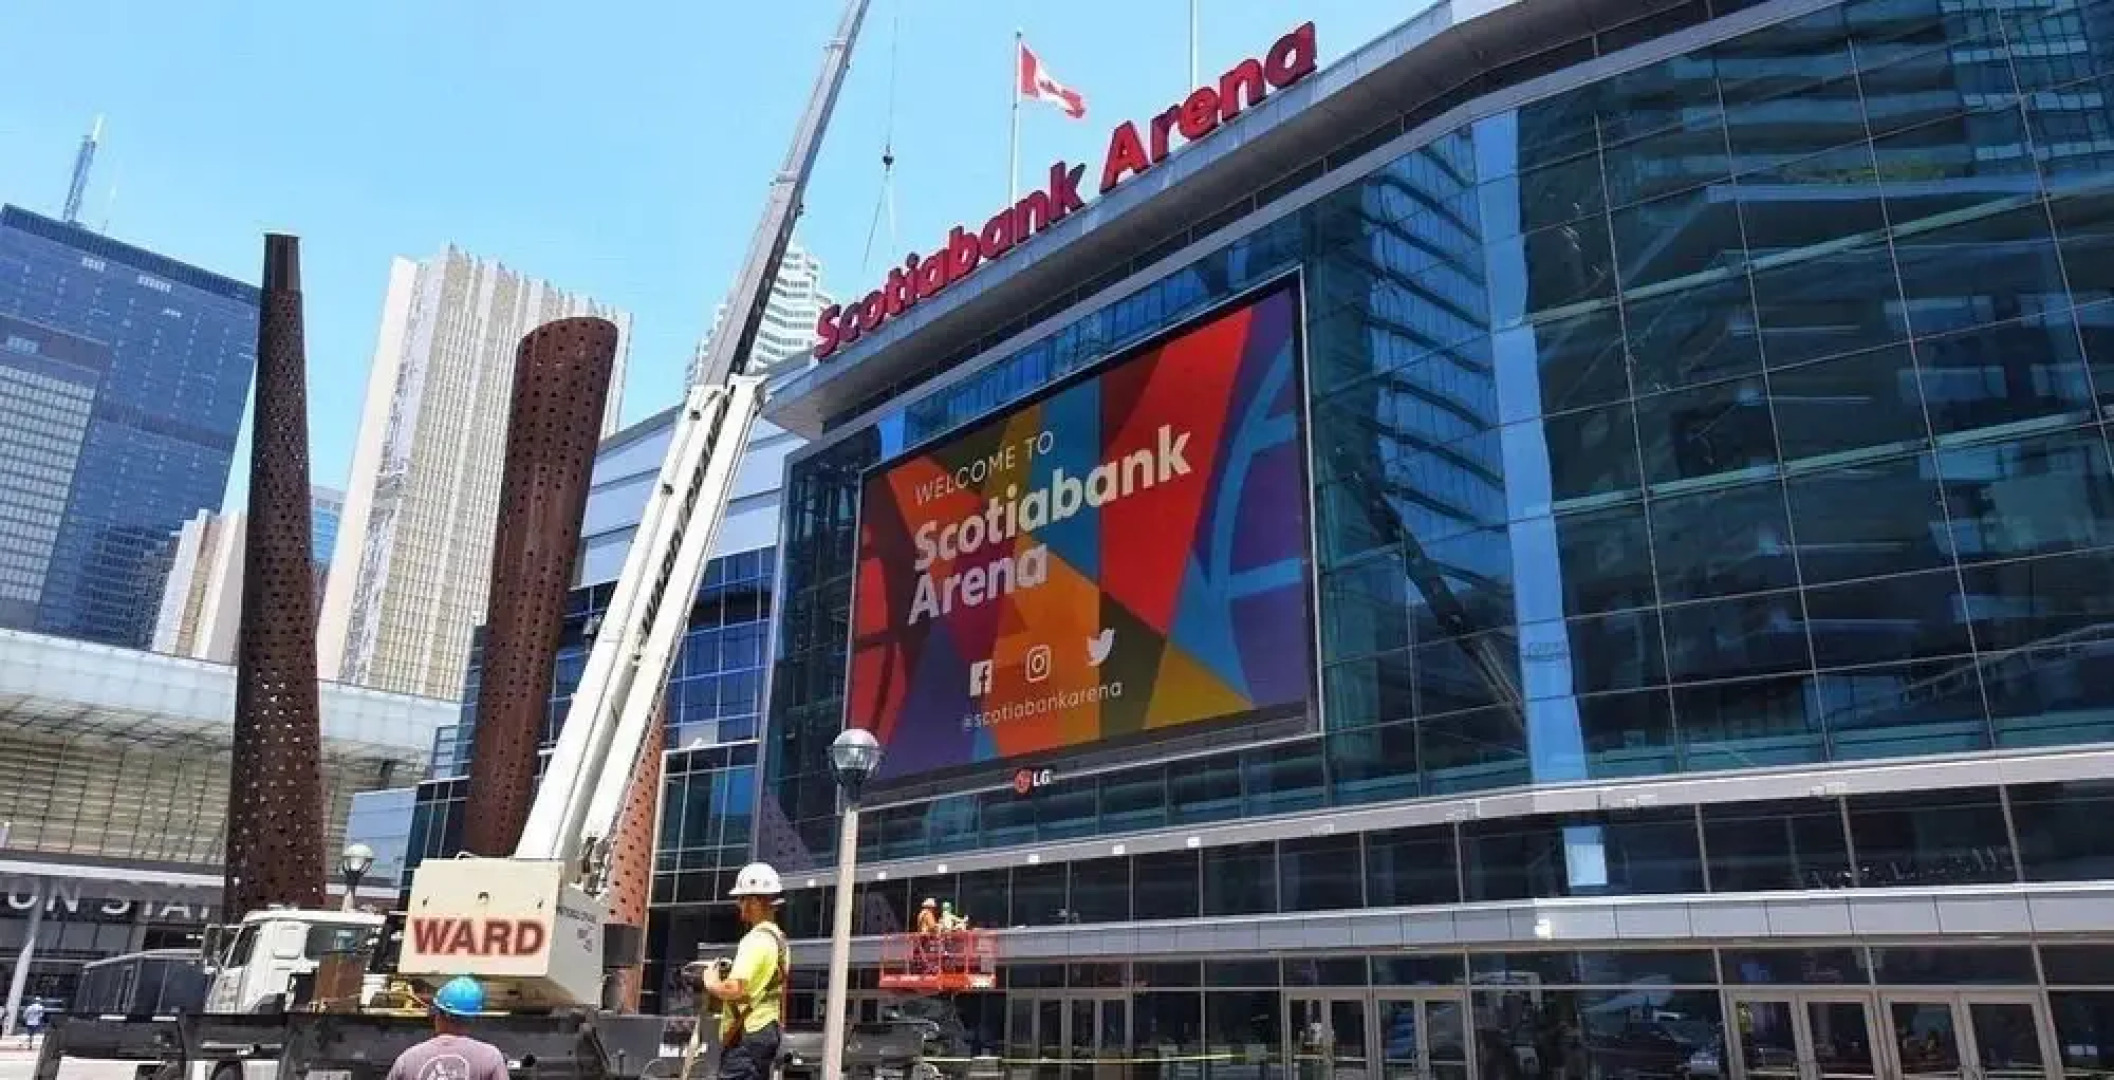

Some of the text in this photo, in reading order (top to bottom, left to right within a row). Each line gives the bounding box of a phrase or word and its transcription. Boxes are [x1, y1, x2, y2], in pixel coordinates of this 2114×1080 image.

[813, 20, 1318, 360] Scotiabank Arena
[913, 423, 1193, 571] Scotiabank
[914, 430, 1054, 506] WELCOME TO
[908, 543, 1048, 626] Arena
[962, 681, 1124, 732] @scotiabankarena
[1033, 769, 1053, 787] LG
[412, 918, 546, 956] WARD
